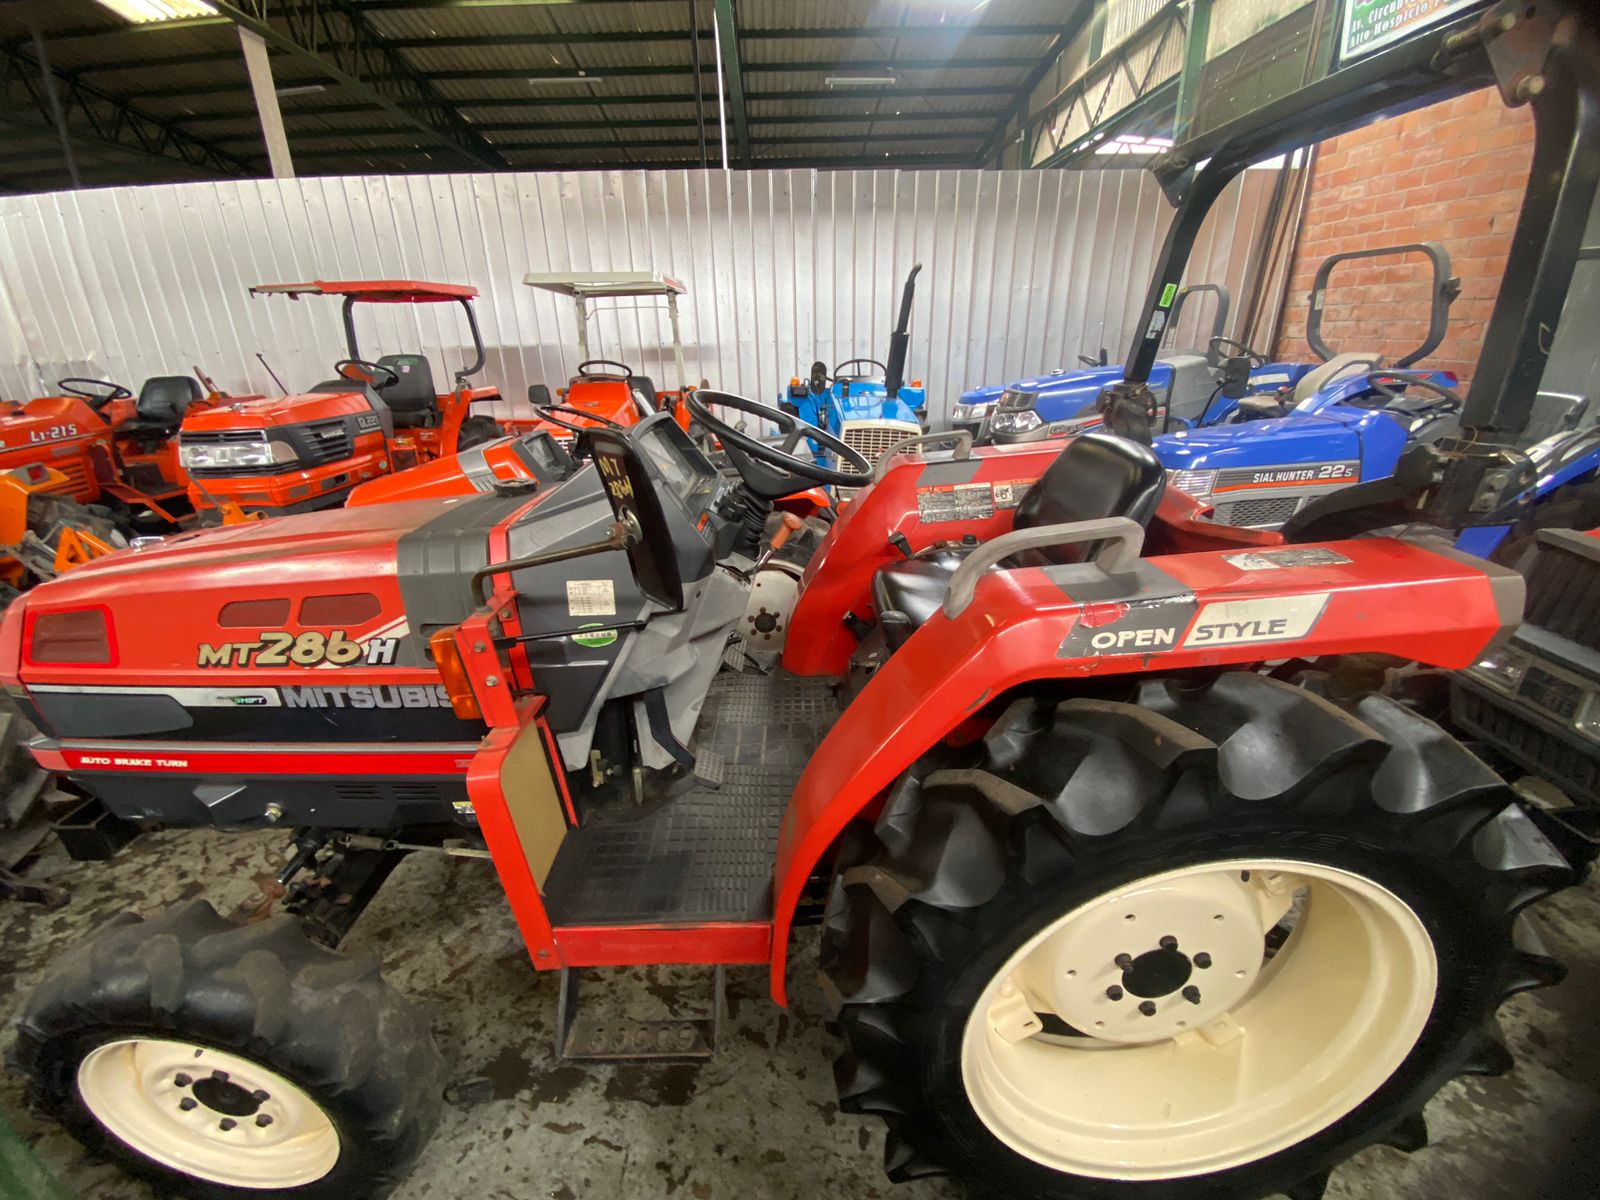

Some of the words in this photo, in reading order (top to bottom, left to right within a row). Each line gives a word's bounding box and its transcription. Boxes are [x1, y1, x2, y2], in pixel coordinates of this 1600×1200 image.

[1349, 30, 1370, 48] Alto
[1374, 2, 1428, 36] Hospicio
[1253, 473, 1274, 483] SIAL
[1275, 471, 1314, 481] HUNTER
[1091, 628, 1175, 649] OPEN
[1195, 619, 1287, 641] STYLE
[80, 757, 111, 765] AUTO
[114, 758, 152, 766] BRAKE
[156, 759, 188, 767] TURN
